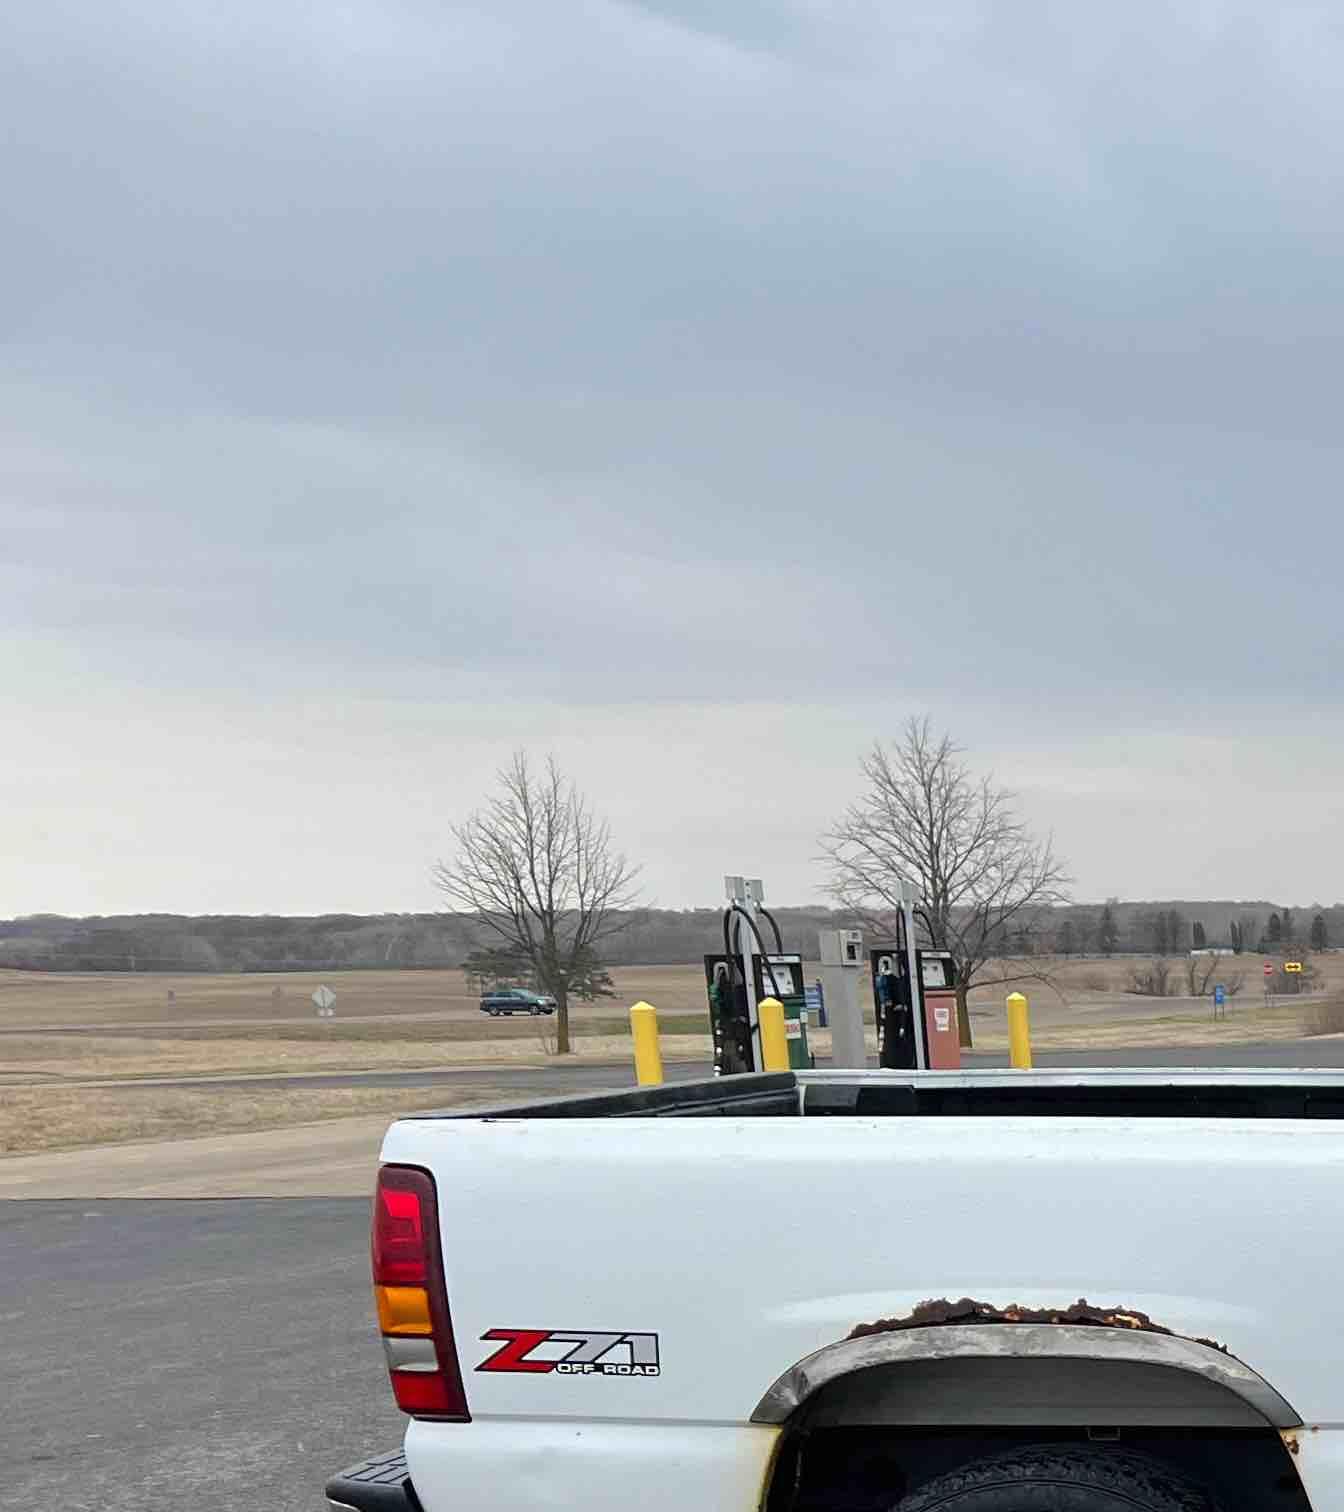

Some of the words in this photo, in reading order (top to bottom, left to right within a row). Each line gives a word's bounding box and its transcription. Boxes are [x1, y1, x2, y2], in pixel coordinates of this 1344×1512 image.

[474, 1329, 660, 1373] Z71
[557, 1363, 595, 1374] OFF
[603, 1364, 660, 1375] ROAD
